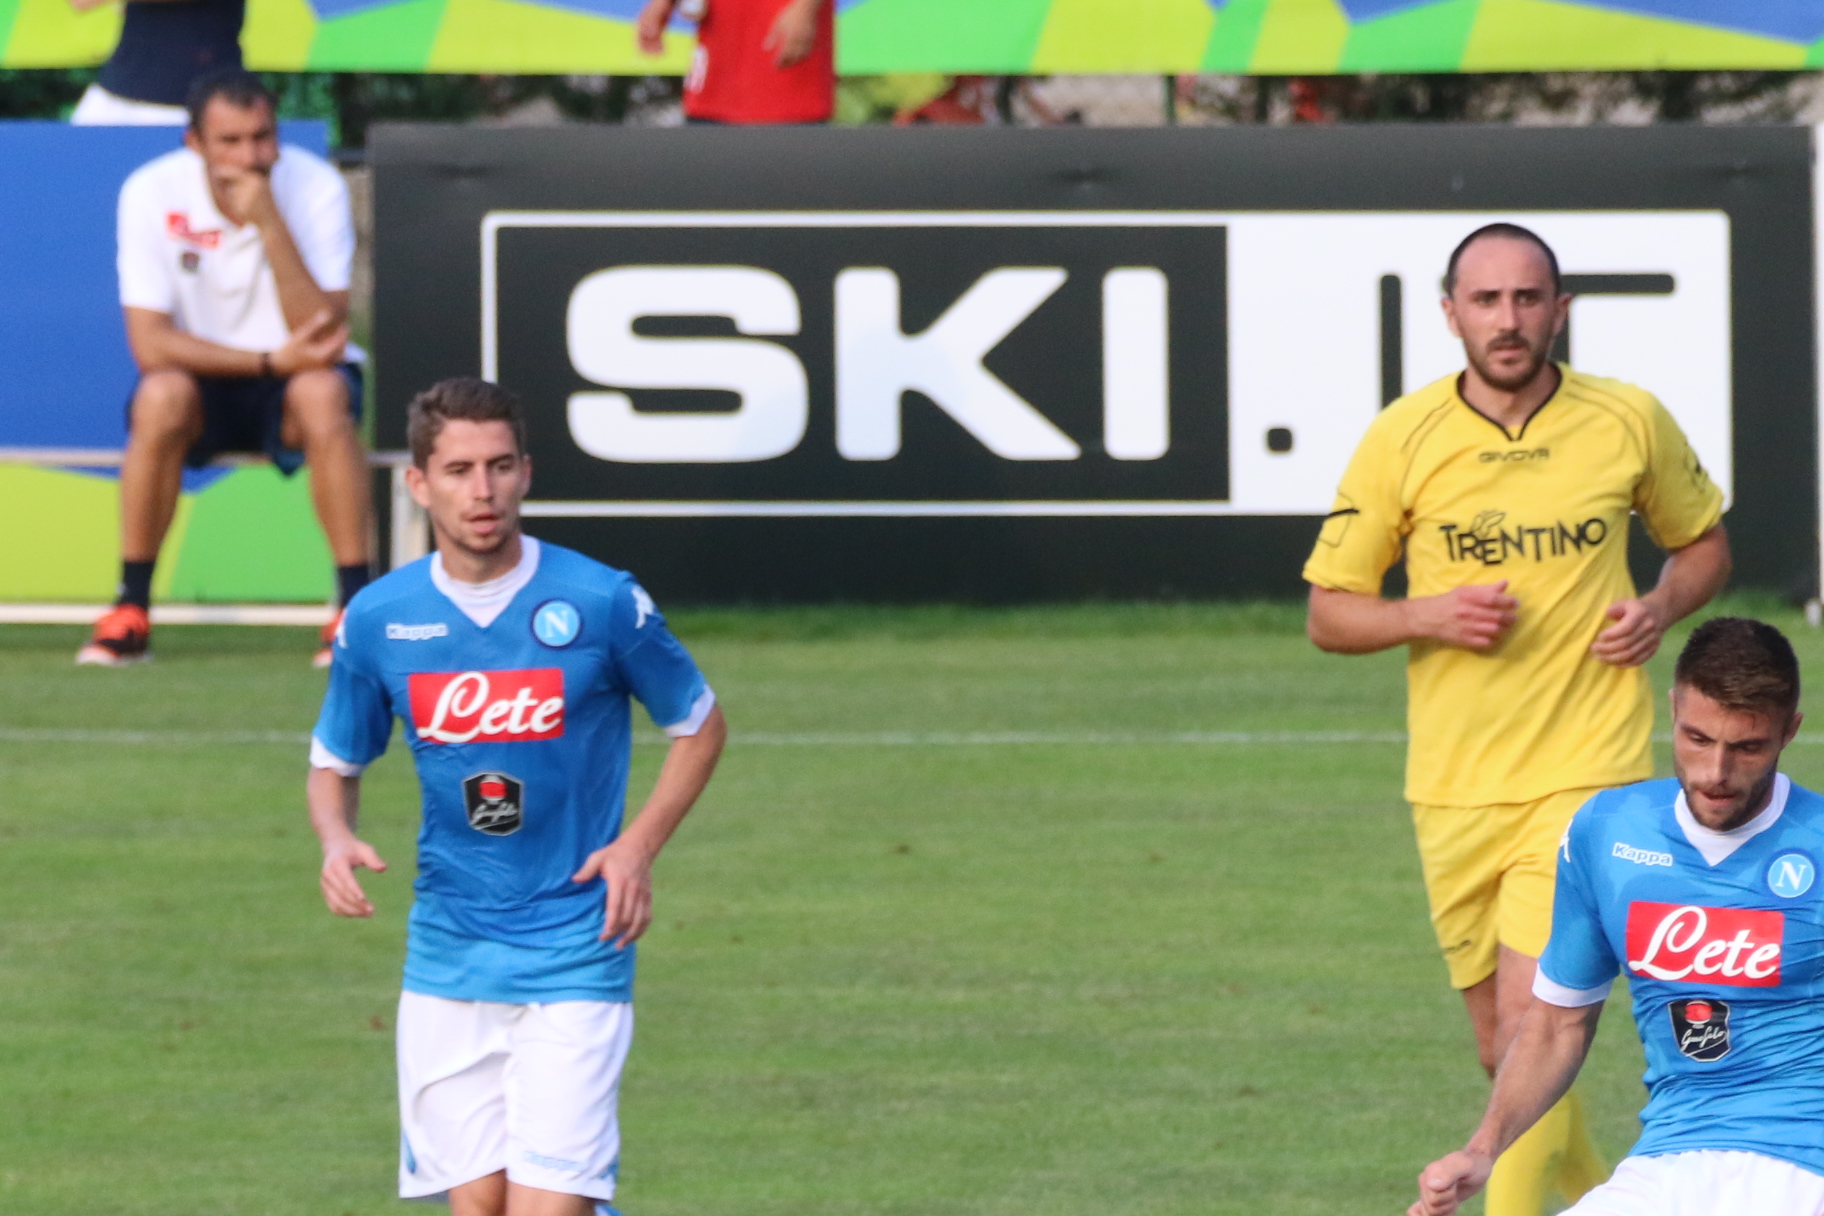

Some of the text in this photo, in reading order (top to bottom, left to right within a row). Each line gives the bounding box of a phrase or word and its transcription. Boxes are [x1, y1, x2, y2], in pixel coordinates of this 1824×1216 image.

[1438, 517, 1608, 566] TRENTINO
[543, 610, 571, 637] N
[416, 670, 563, 743] Lete
[1611, 842, 1674, 868] Kappa
[1775, 860, 1807, 891] N
[1627, 904, 1781, 981] Lete
